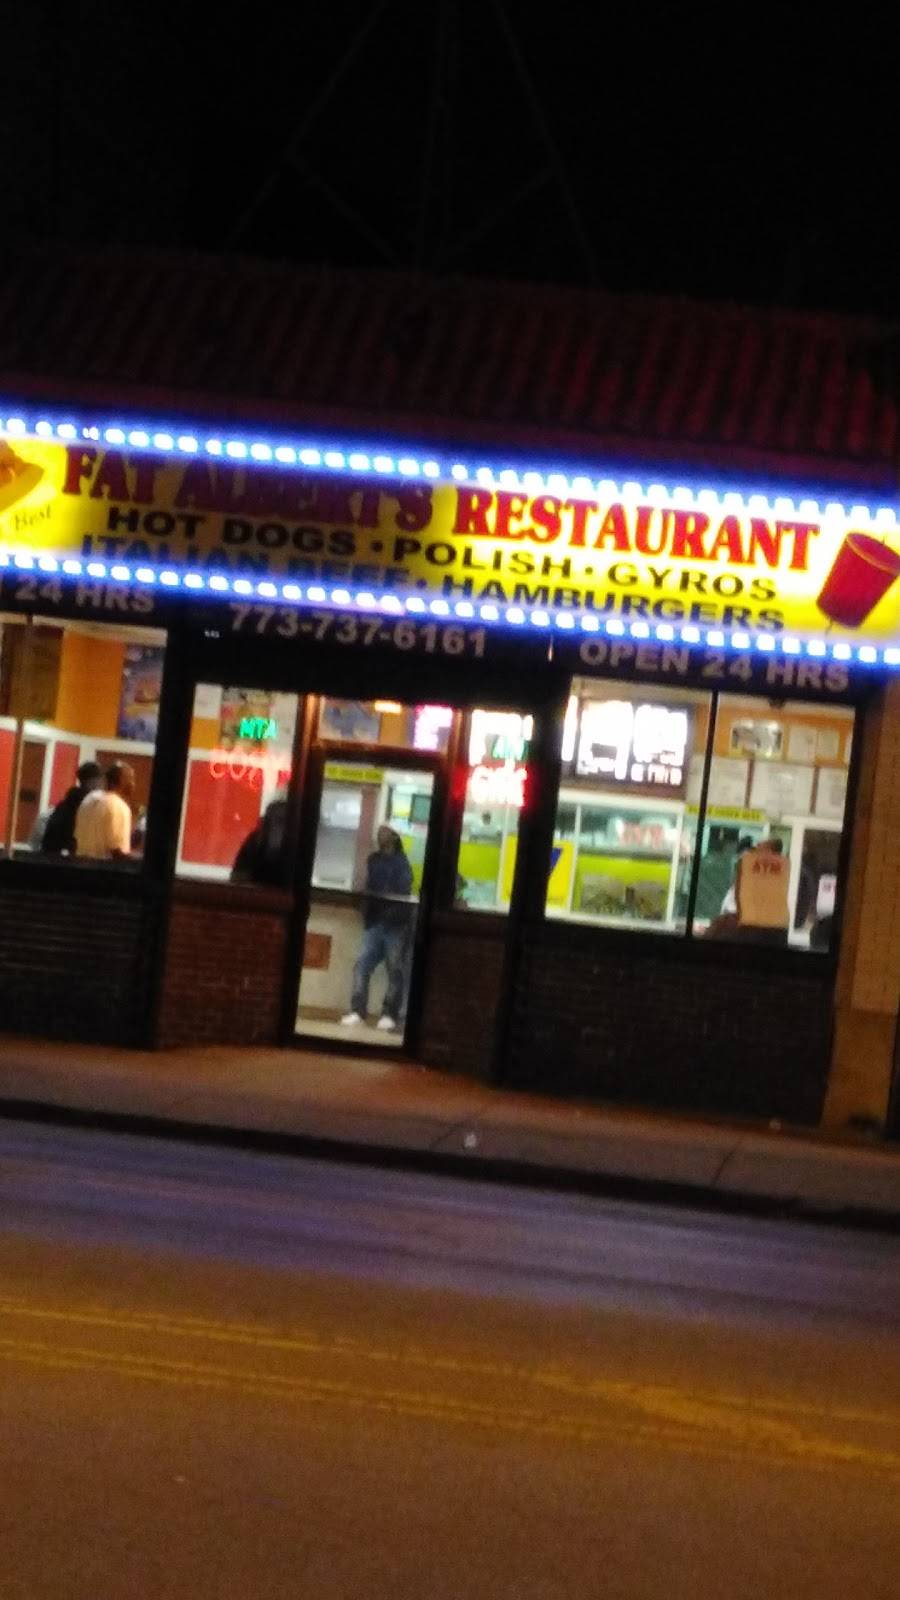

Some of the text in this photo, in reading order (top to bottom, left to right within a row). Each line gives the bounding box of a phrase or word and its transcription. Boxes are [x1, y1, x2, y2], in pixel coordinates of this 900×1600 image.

[62, 446, 164, 504] FAT
[453, 486, 820, 571] RESTAURANT
[82, 534, 270, 576] ITALIAN
[442, 575, 785, 633] HAMBURGERS
[107, 507, 777, 601] HOT DOGS POLISH GYROS
[15, 575, 155, 613] 24 HRS
[229, 604, 487, 658] 773-737-6161
[579, 639, 849, 692] OPEN 24 HRS
